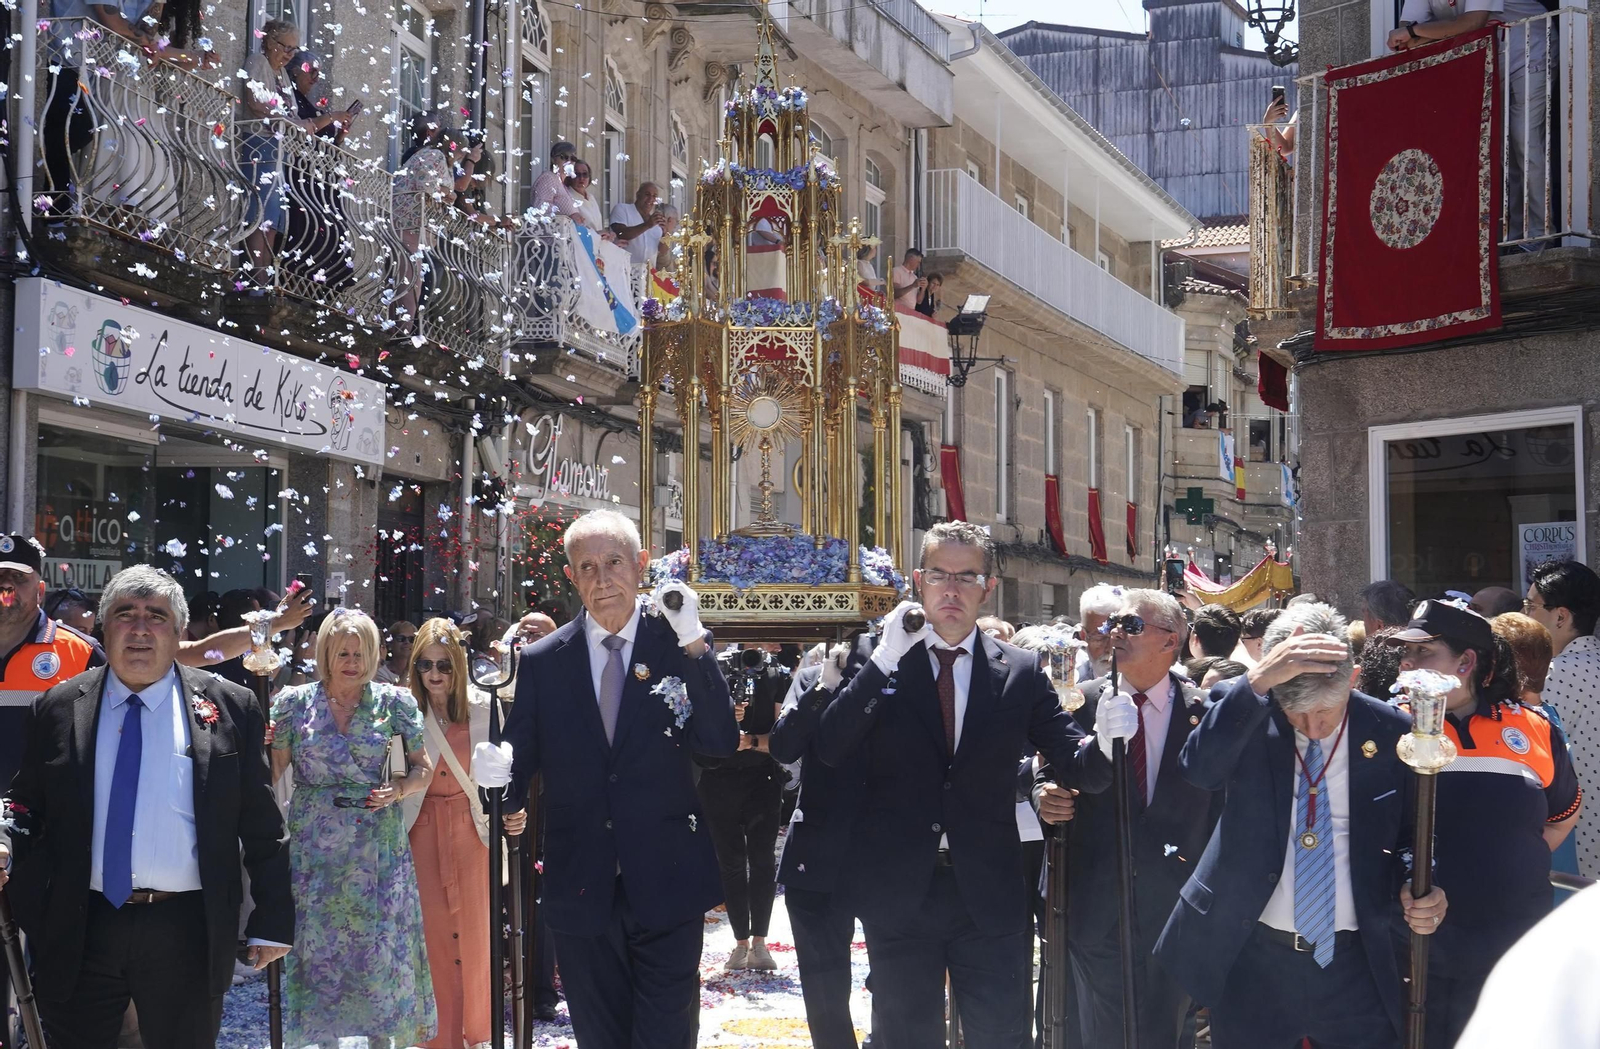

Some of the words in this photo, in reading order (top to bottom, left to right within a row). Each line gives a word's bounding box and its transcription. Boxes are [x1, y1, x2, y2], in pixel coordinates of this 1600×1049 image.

[135, 329, 168, 388] La
[178, 345, 235, 404] tienda
[244, 368, 266, 411] de
[1523, 526, 1575, 544] CORPUS
[42, 561, 114, 590] ALQUILA
